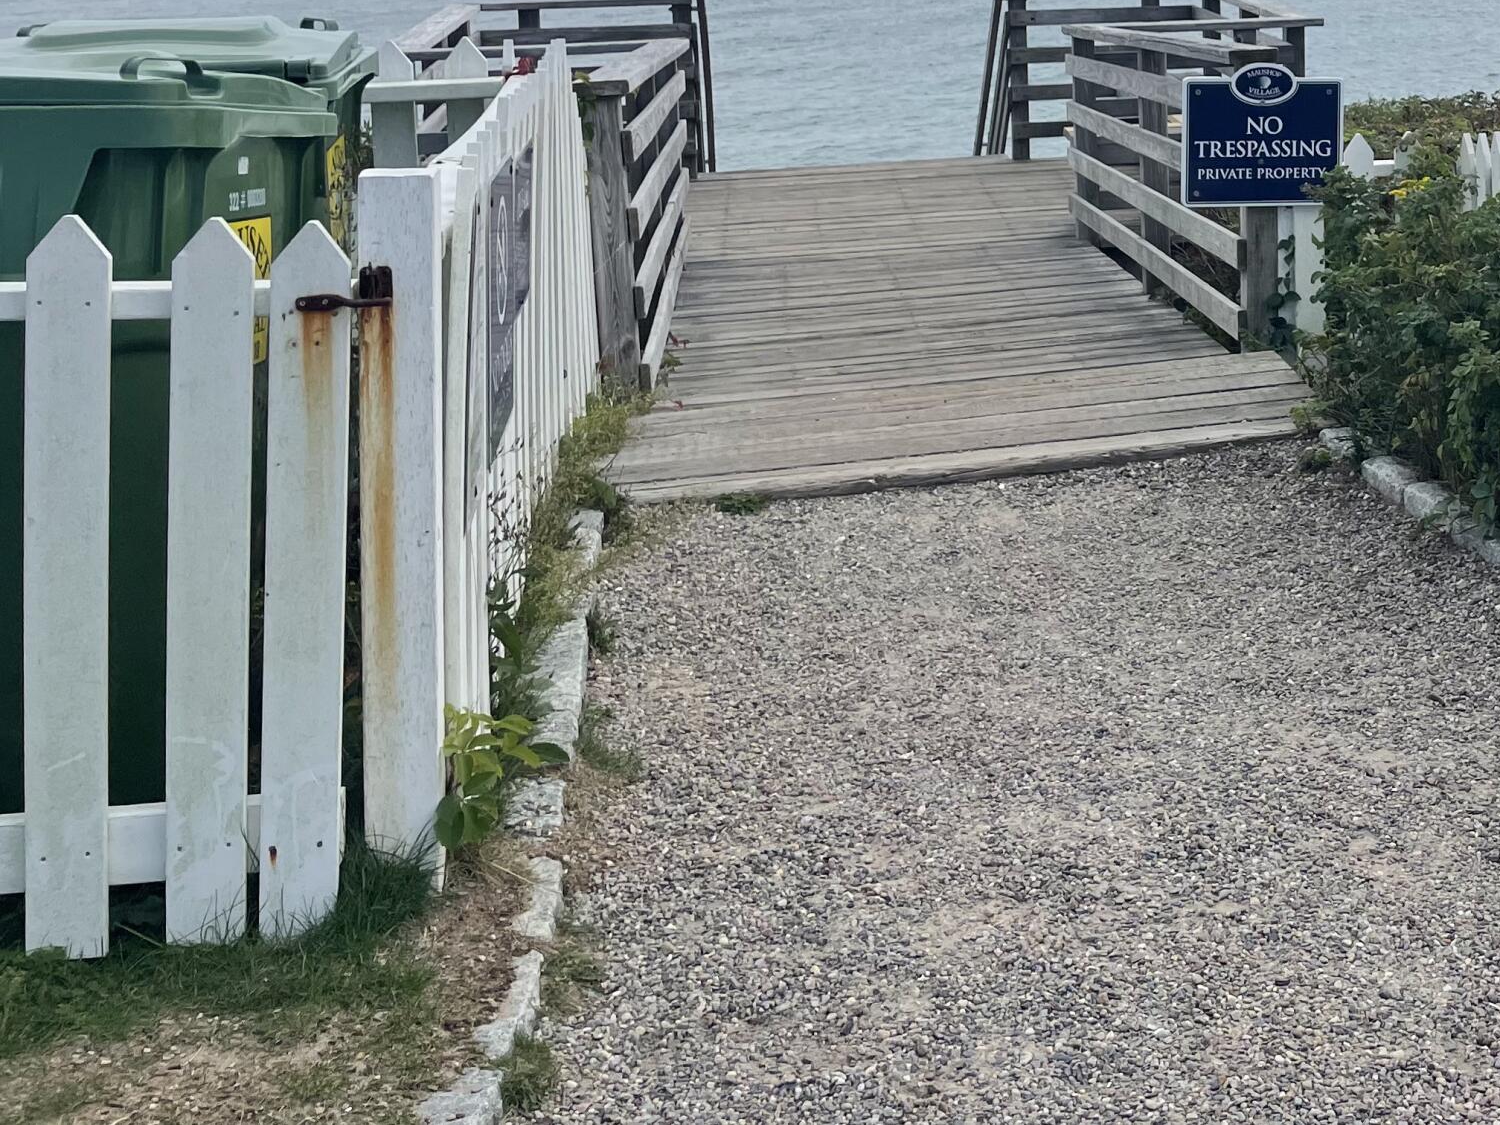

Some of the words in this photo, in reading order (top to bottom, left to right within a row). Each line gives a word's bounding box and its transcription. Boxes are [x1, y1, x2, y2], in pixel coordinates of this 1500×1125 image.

[1249, 86, 1280, 96] VILLAGE
[1246, 115, 1284, 135] NO
[1193, 139, 1332, 158] TRESPASSING
[1197, 167, 1253, 180] PRIVATE
[1257, 166, 1327, 180] PROPERTY
